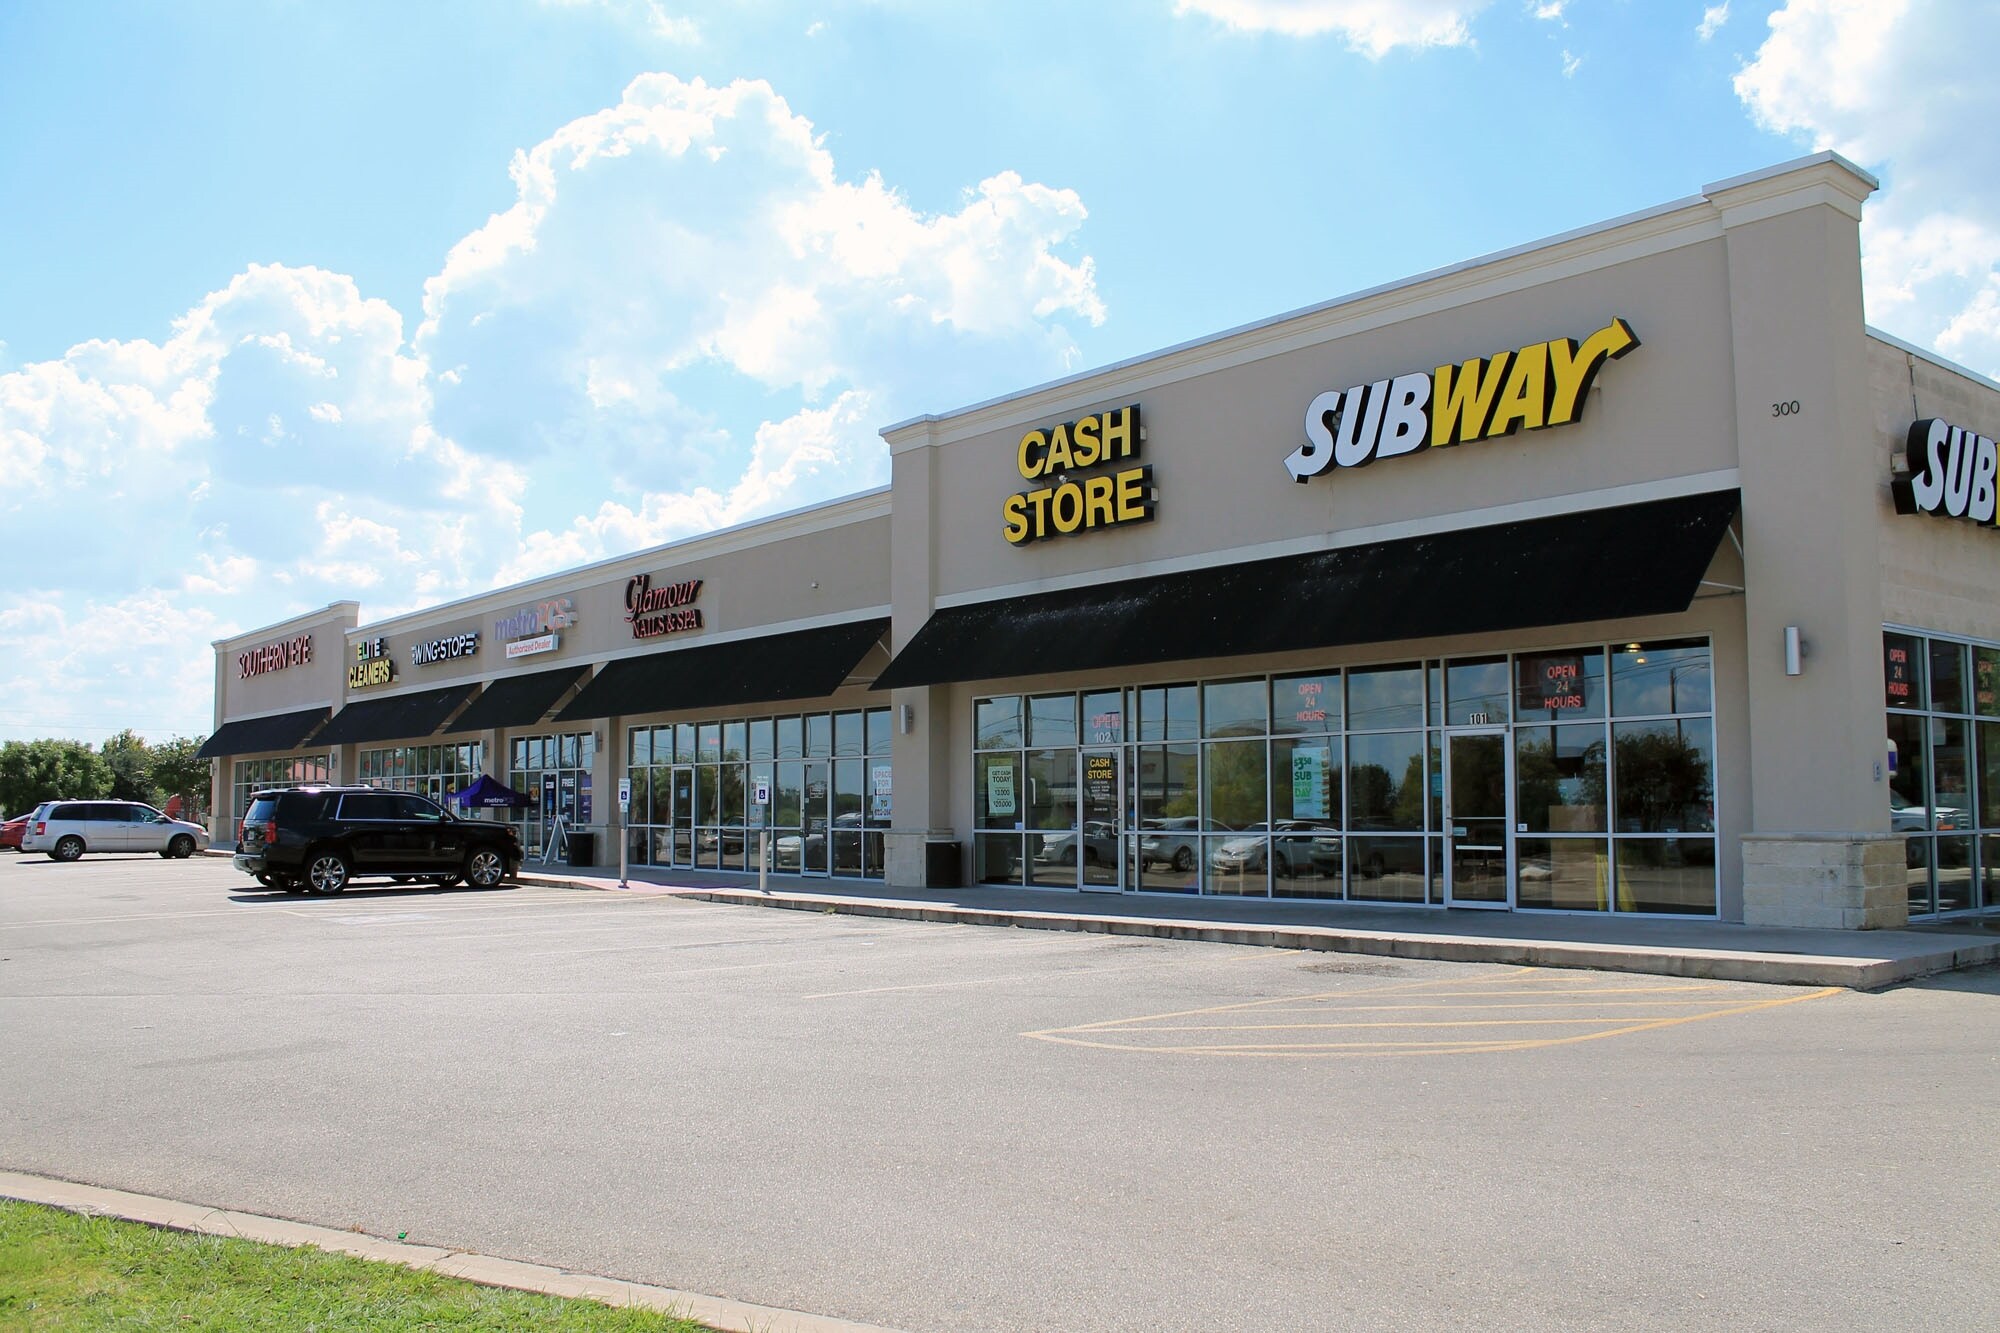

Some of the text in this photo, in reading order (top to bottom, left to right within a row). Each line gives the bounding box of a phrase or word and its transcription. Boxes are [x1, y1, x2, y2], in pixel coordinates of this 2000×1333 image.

[1283, 316, 1641, 483] SUBWAY
[1771, 400, 1800, 417] 300
[1017, 406, 1132, 480] CASH
[1911, 418, 2000, 525] SUB
[1003, 468, 1145, 543] STORE
[624, 575, 698, 622] Glamour
[632, 609, 698, 638] NAILS & SPA
[357, 638, 382, 661] ELITE
[508, 640, 552, 656] Authorized Dealer
[1890, 648, 1907, 663] OPEN
[238, 635, 312, 680] SOUTHERN EYE
[348, 659, 391, 688] CLEANERS
[1547, 664, 1577, 679] OPEN
[1298, 682, 1322, 695] OPEN
[1556, 681, 1569, 693] 24
[1888, 681, 1908, 696] HOURS
[1305, 697, 1316, 708] 24
[1544, 695, 1581, 709] HOURS
[1091, 713, 1121, 729] OPEN
[1296, 710, 1326, 722] HOURS
[1470, 713, 1489, 724] 101
[1094, 731, 1112, 743] 102
[1089, 758, 1111, 768] CASH
[1087, 769, 1112, 779] STORE
[1294, 771, 1312, 781] SUB
[561, 778, 575, 788] FREE
[1294, 788, 1311, 797] DAY
